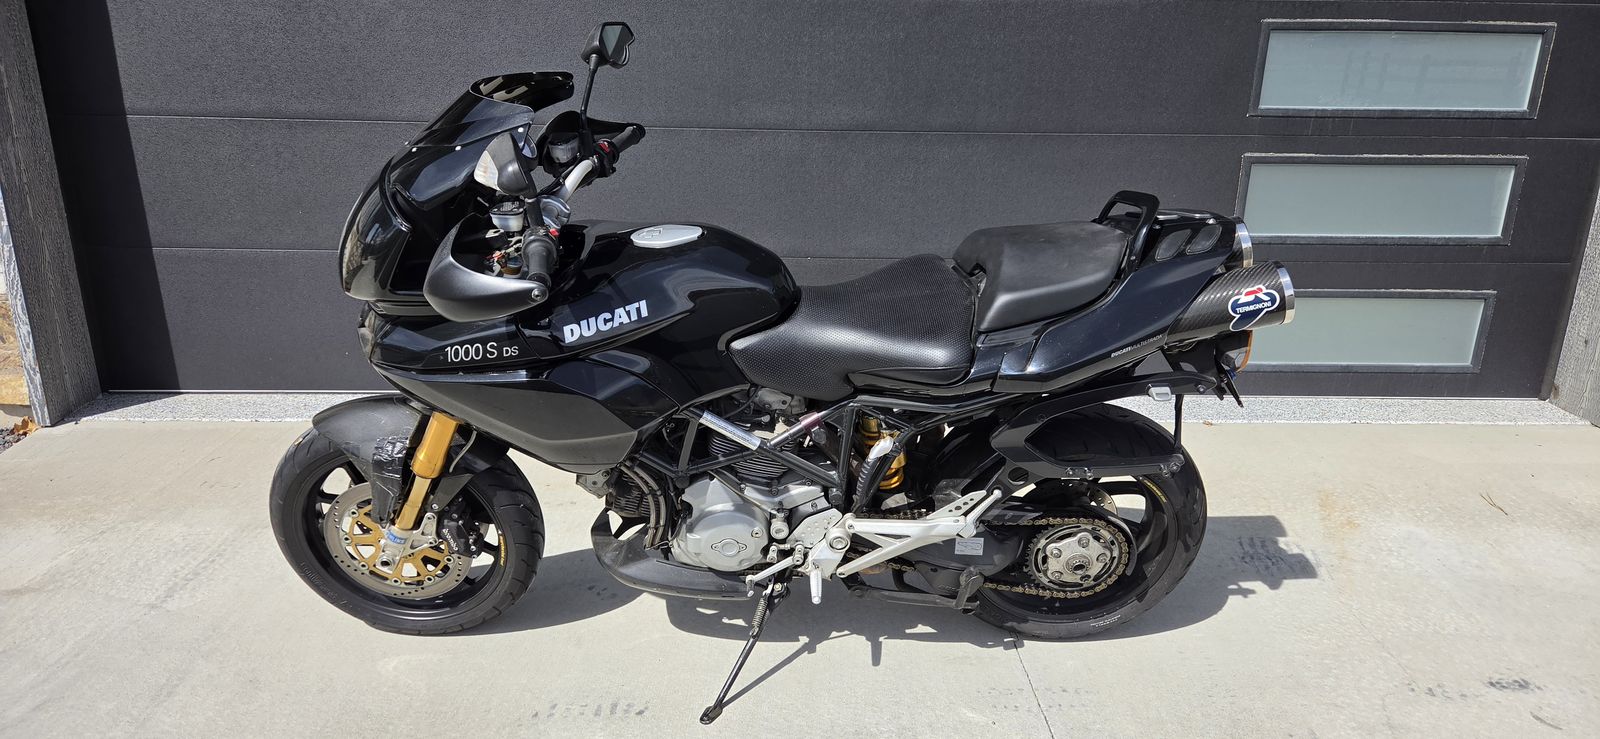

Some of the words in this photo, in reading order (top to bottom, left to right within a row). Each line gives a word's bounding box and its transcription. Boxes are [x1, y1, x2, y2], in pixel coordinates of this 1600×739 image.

[1235, 301, 1272, 314] TERMIGNONI
[563, 300, 648, 343] DUCATI
[445, 345, 483, 362] 1000
[486, 342, 498, 358] S
[503, 346, 519, 357] DS
